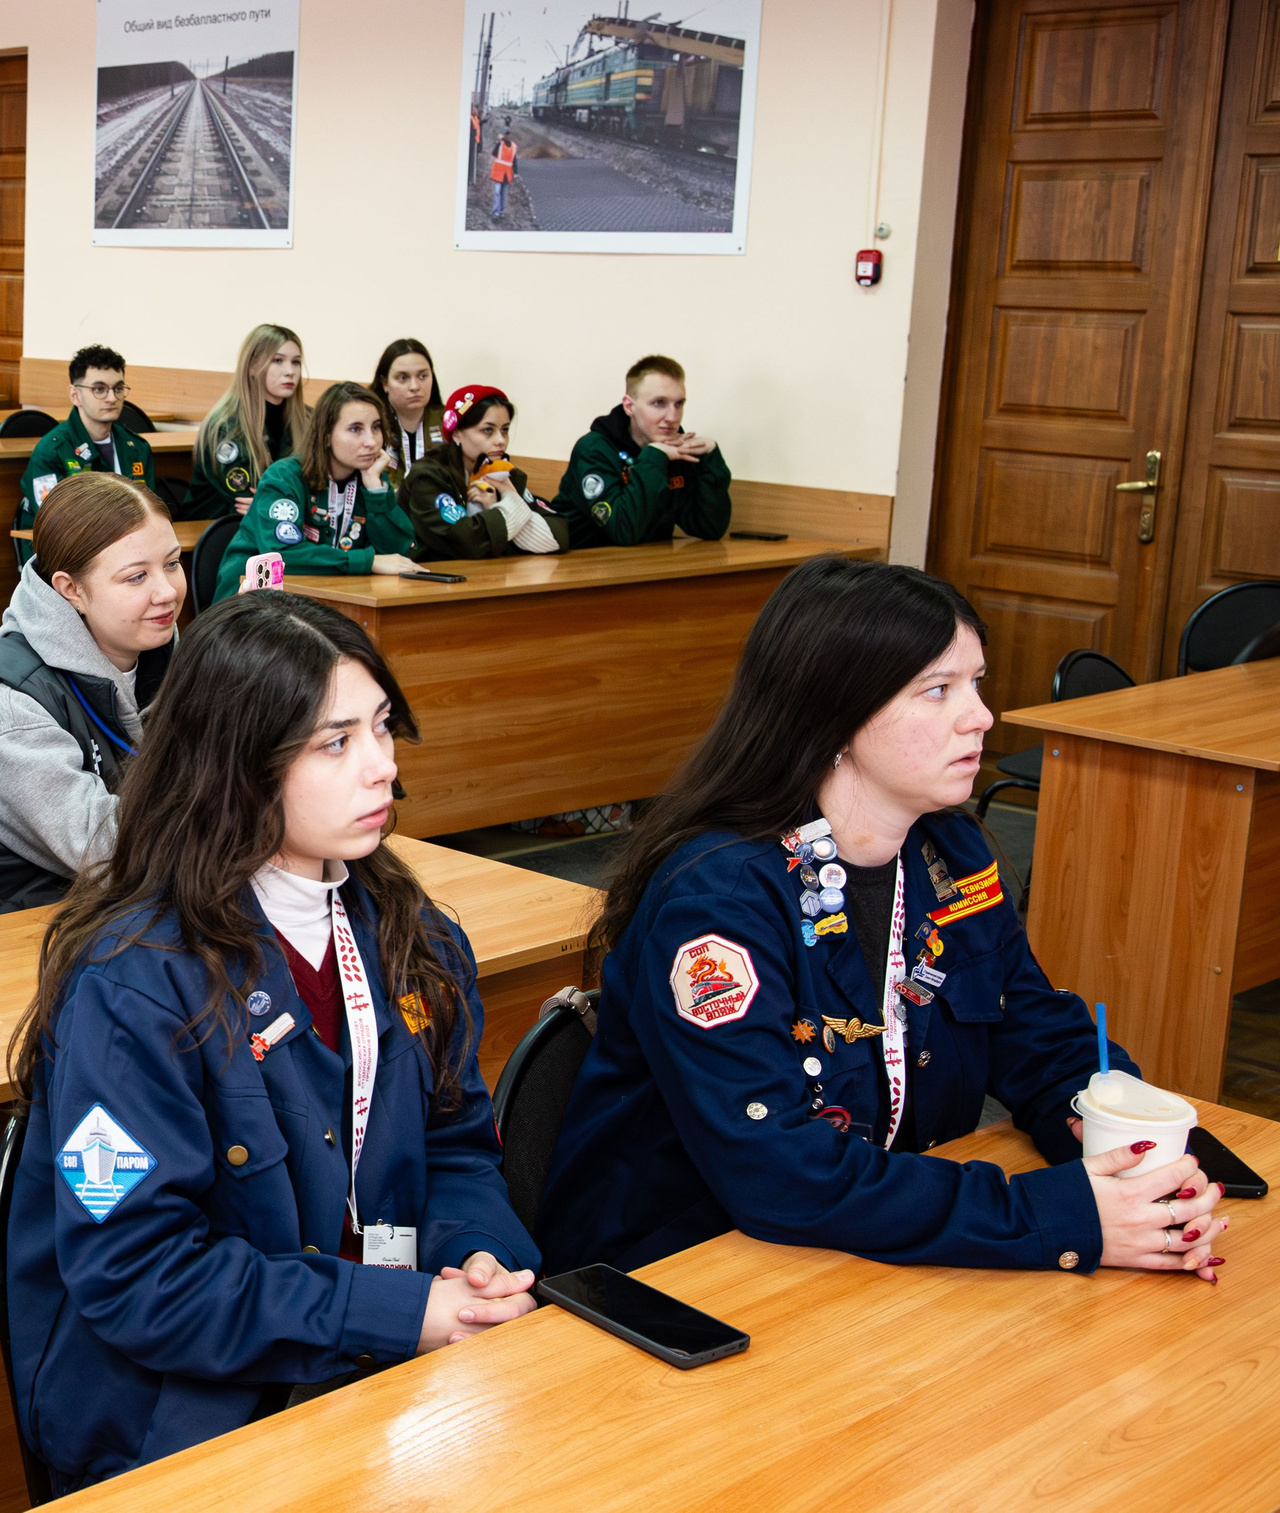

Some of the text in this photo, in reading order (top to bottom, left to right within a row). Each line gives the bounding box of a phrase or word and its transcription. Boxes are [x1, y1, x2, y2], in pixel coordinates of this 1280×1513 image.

[124, 9, 270, 33] Общий вид безбалластного пути
[948, 891, 988, 912] КОМИССИЯ
[689, 945, 710, 958] СОП
[691, 990, 746, 1016] ВОСТОЧНЫЙ
[705, 1004, 738, 1021] ВОЯЖ
[116, 1156, 148, 1170] ПАРОМ
